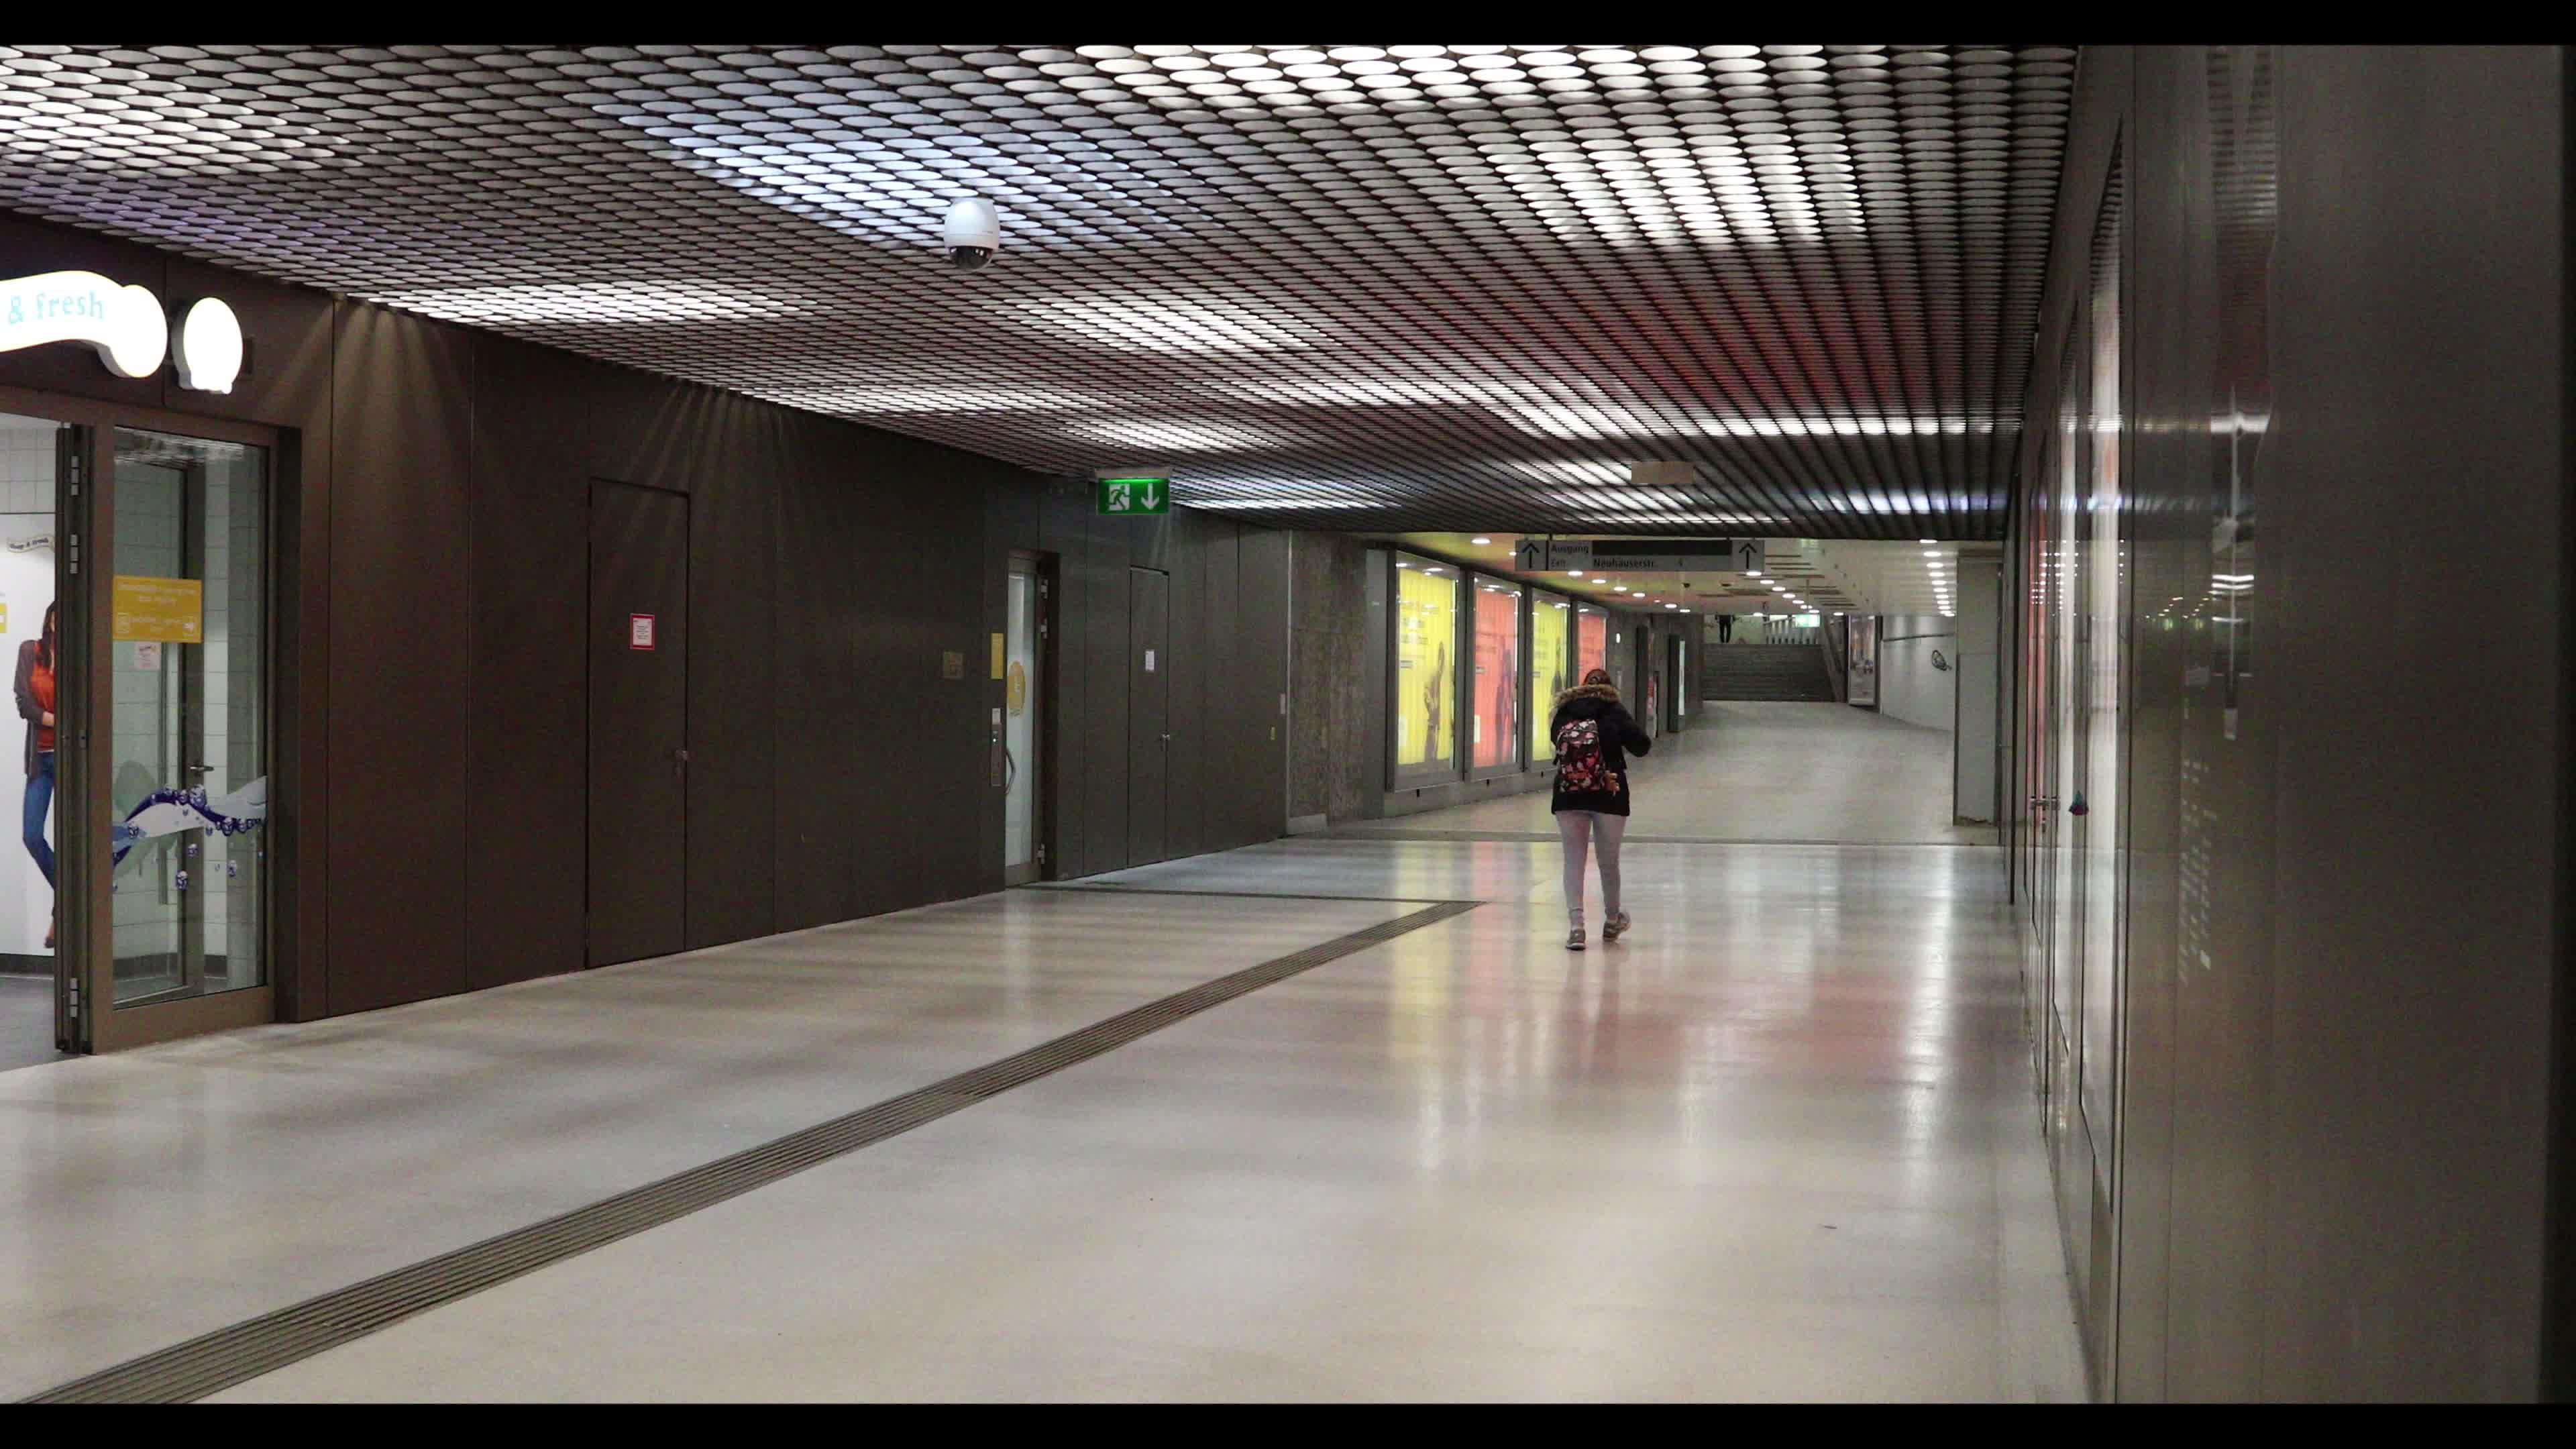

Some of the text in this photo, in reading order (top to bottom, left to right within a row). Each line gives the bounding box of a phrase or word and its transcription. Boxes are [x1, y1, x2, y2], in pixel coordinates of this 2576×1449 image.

[8, 290, 104, 325] & fresh
[1551, 544, 1589, 555] Ausgang
